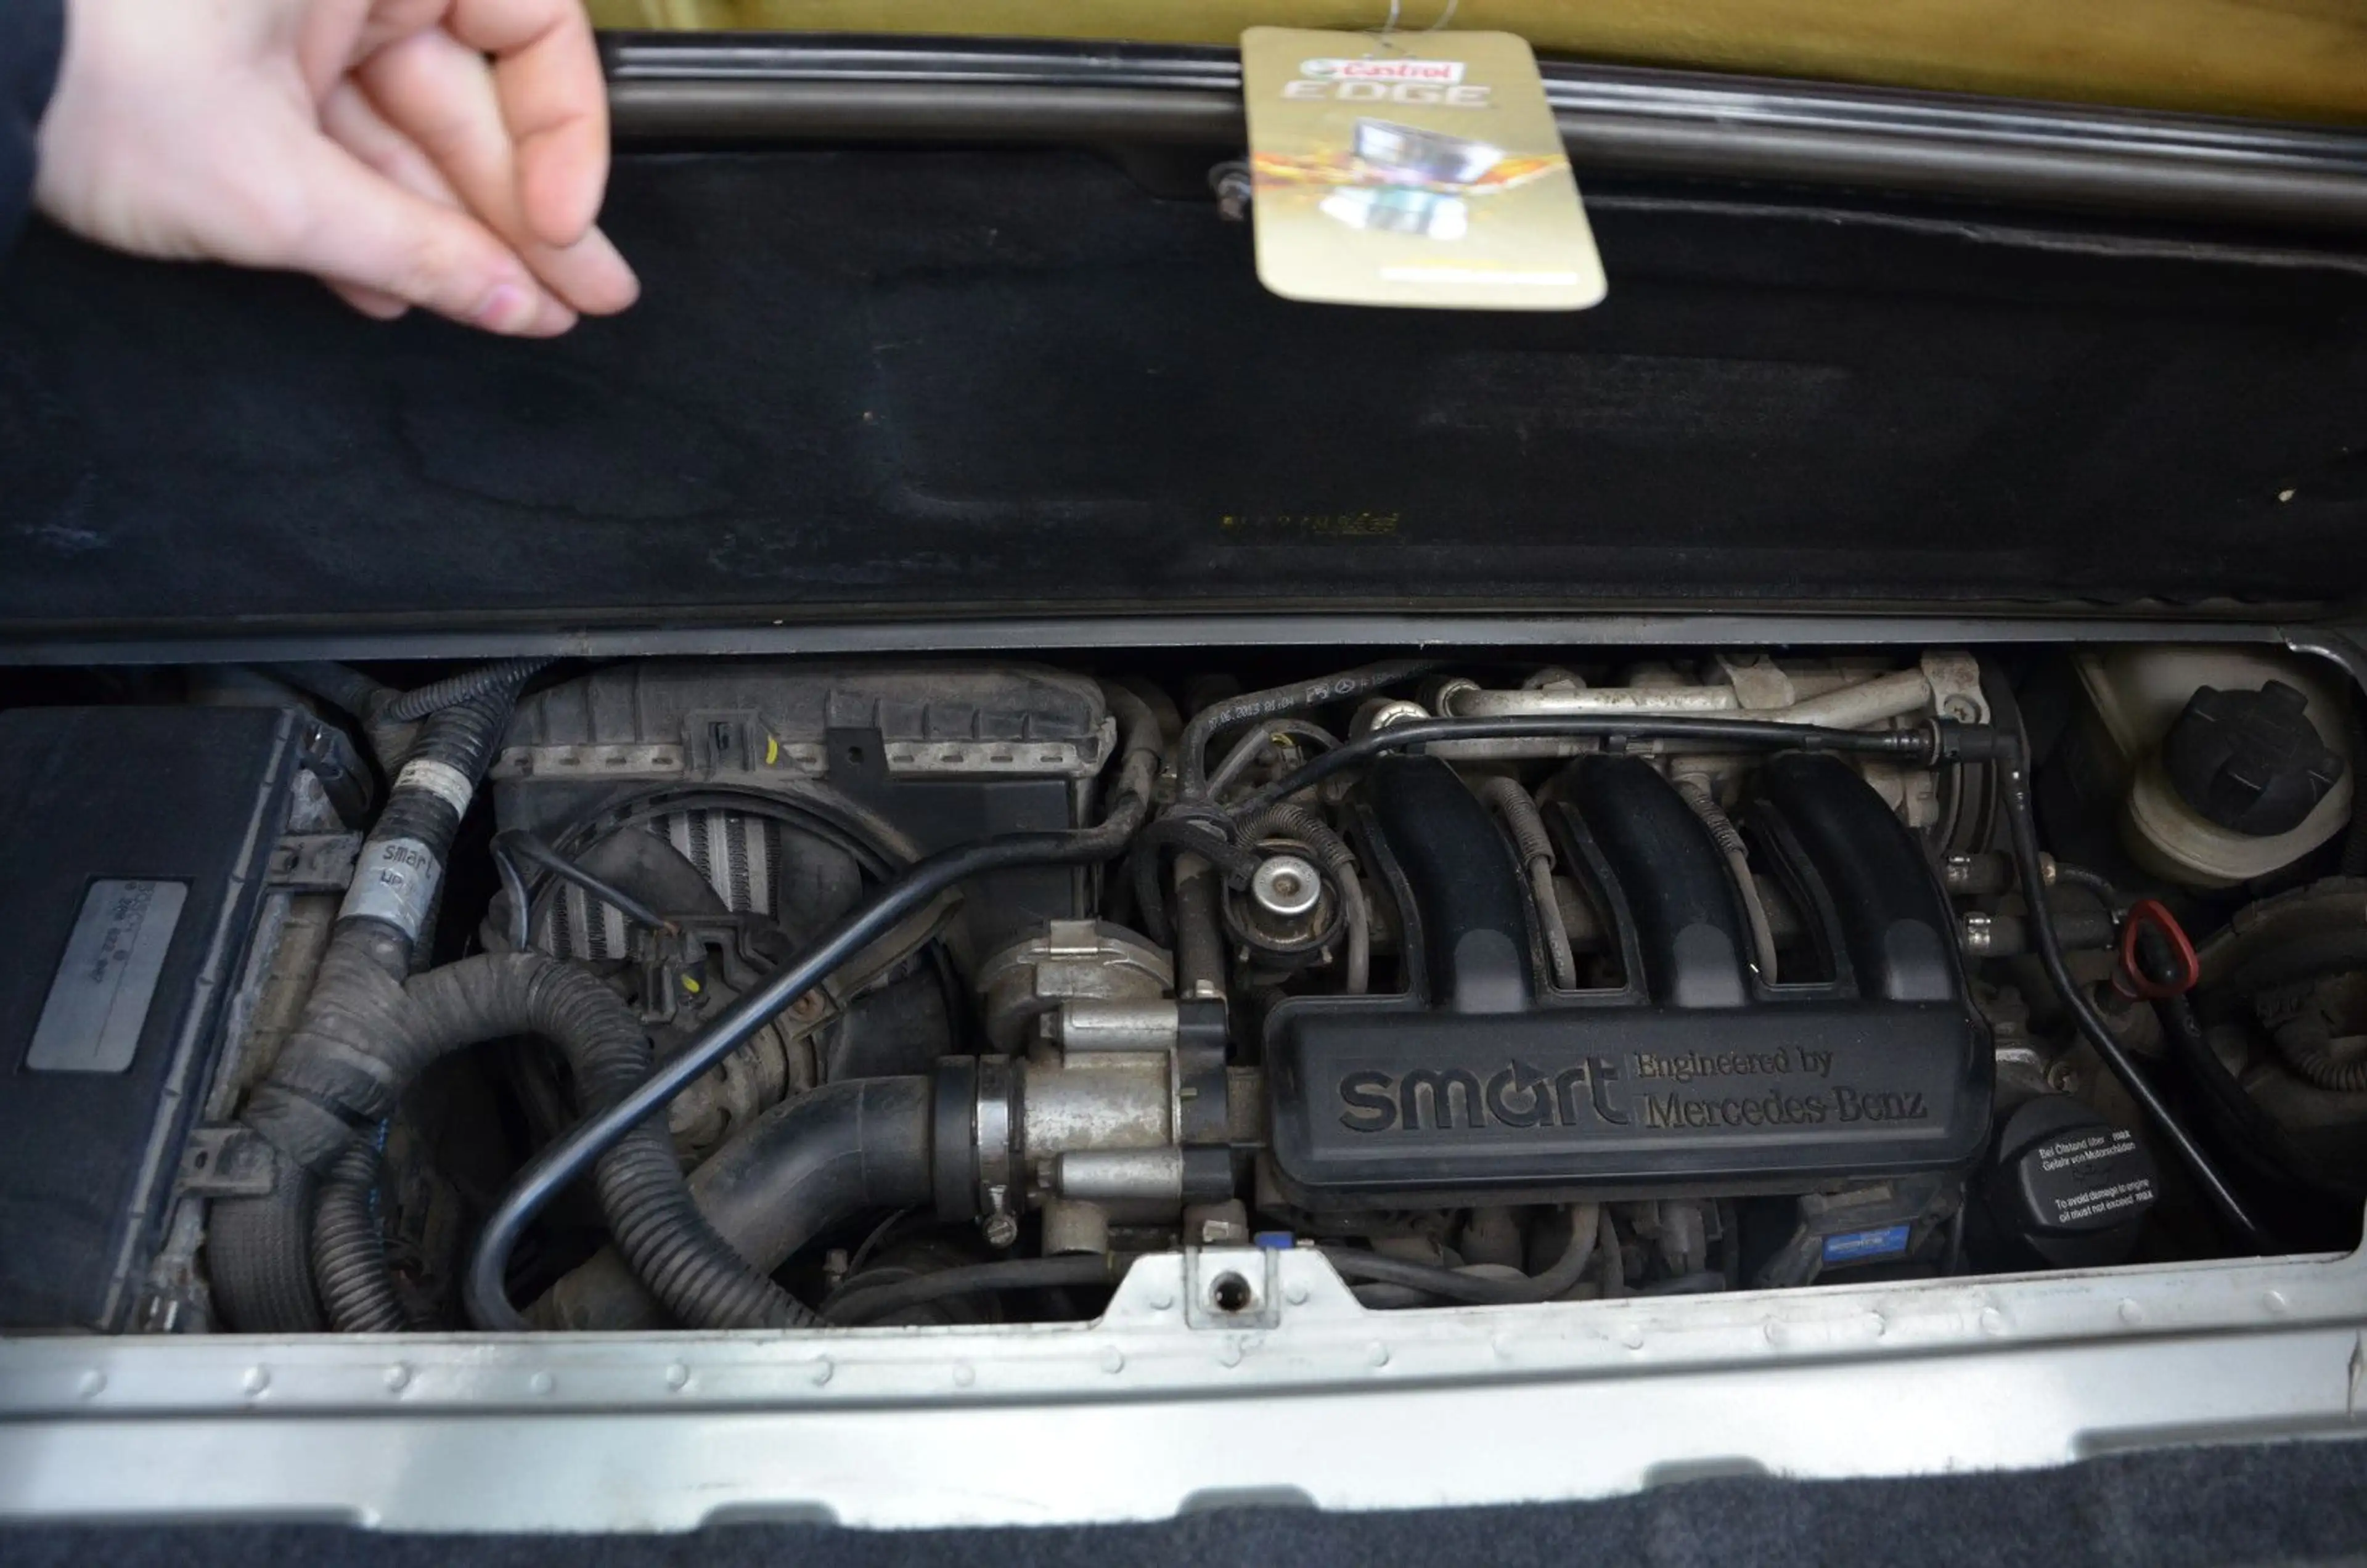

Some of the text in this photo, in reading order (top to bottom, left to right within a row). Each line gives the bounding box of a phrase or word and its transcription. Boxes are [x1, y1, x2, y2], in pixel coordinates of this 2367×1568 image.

[1343, 63, 1451, 80] Castrol
[1281, 81, 1491, 107] EDGE
[383, 845, 432, 880] smart
[1634, 1046, 1833, 1084] Engineered by
[1339, 1058, 1629, 1133] smart
[1642, 1085, 1928, 1129] Mercedes-Benz
[2038, 1146, 2054, 1159] Bei
[2043, 1156, 2070, 1171] Gefahr
[2070, 1154, 2086, 1164] von
[2055, 1178, 2149, 1210] To avoid damage to engine
[2059, 1211, 2070, 1223] oil
[2070, 1206, 2092, 1219] must
[2091, 1202, 2106, 1213] not
[2106, 1194, 2134, 1211] exceed
